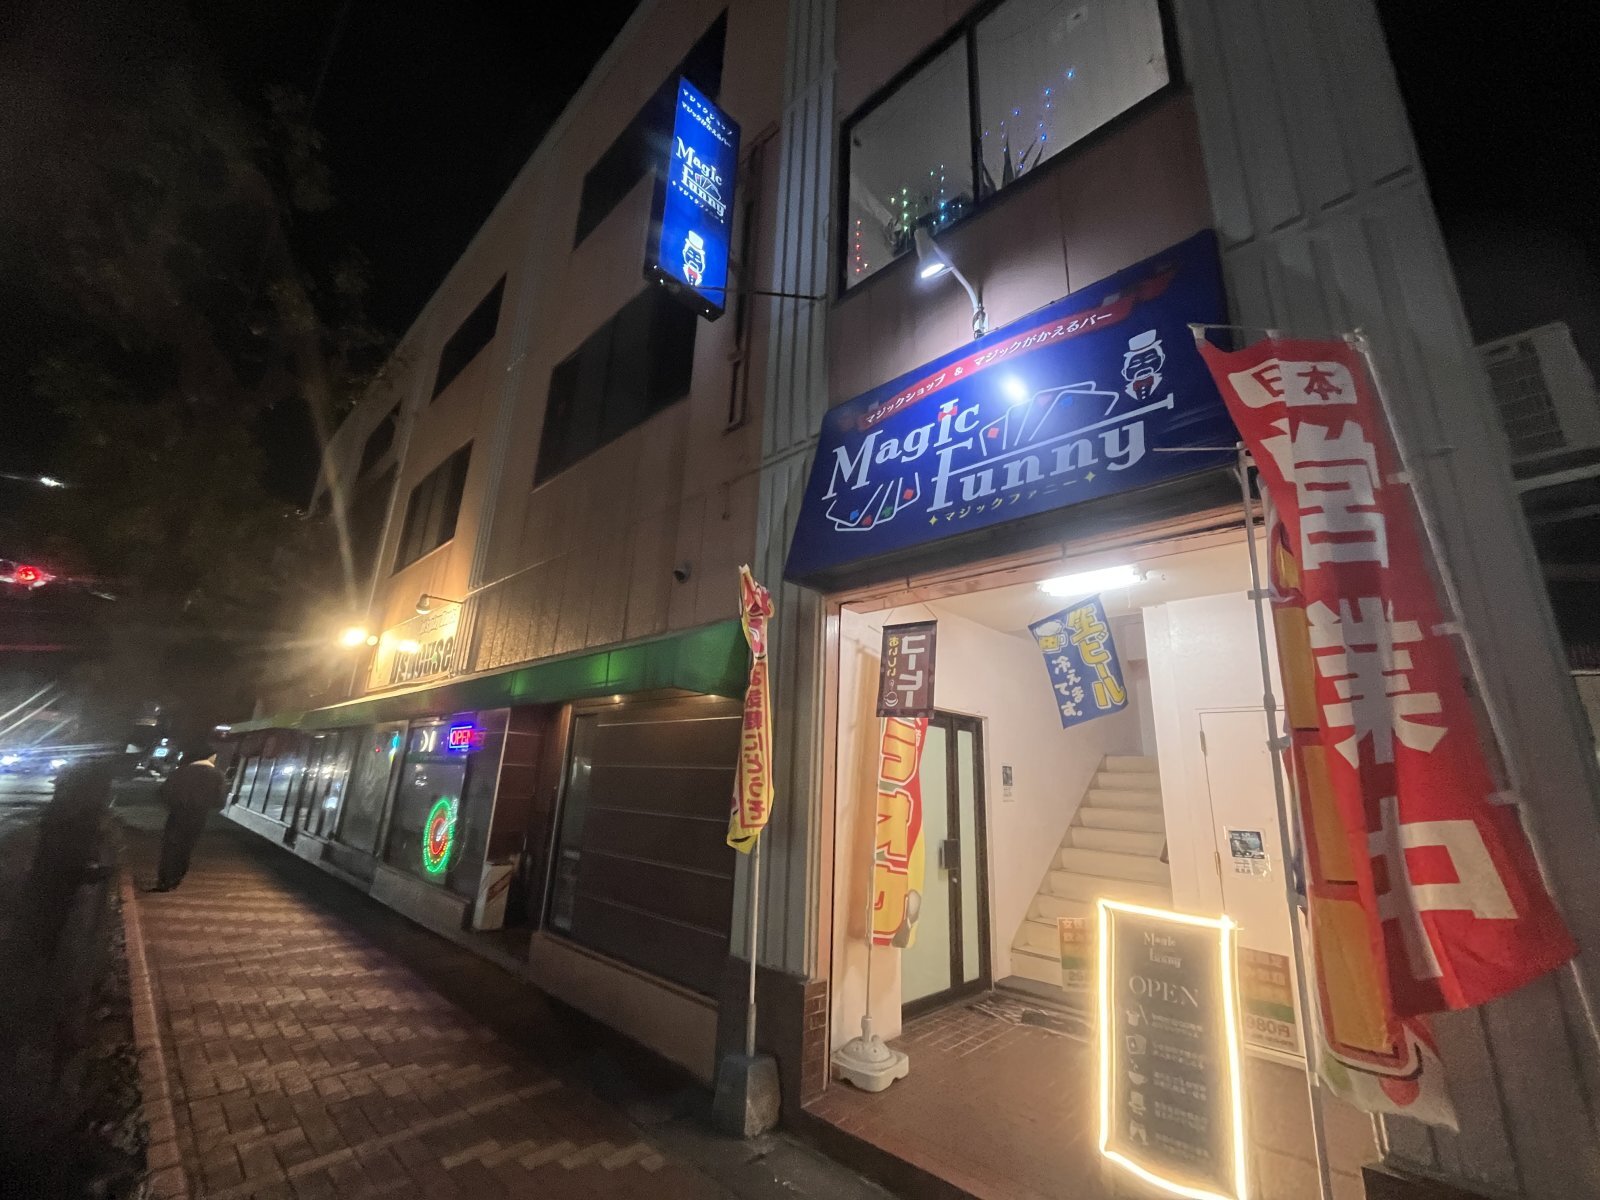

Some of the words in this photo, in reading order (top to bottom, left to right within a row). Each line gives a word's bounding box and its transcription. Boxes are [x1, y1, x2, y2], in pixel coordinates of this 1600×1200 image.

[676, 136, 722, 186] Magic
[681, 164, 727, 217] Funny
[866, 373, 947, 424] マジックショップ
[953, 366, 964, 377] &
[973, 312, 1114, 367] マジックがかえるバー
[821, 397, 981, 502] Magic
[927, 414, 1153, 514] Funny
[945, 480, 1078, 522] マジックファニー
[1066, 603, 1127, 709] 生ビール
[1129, 975, 1199, 1008] OPEN
